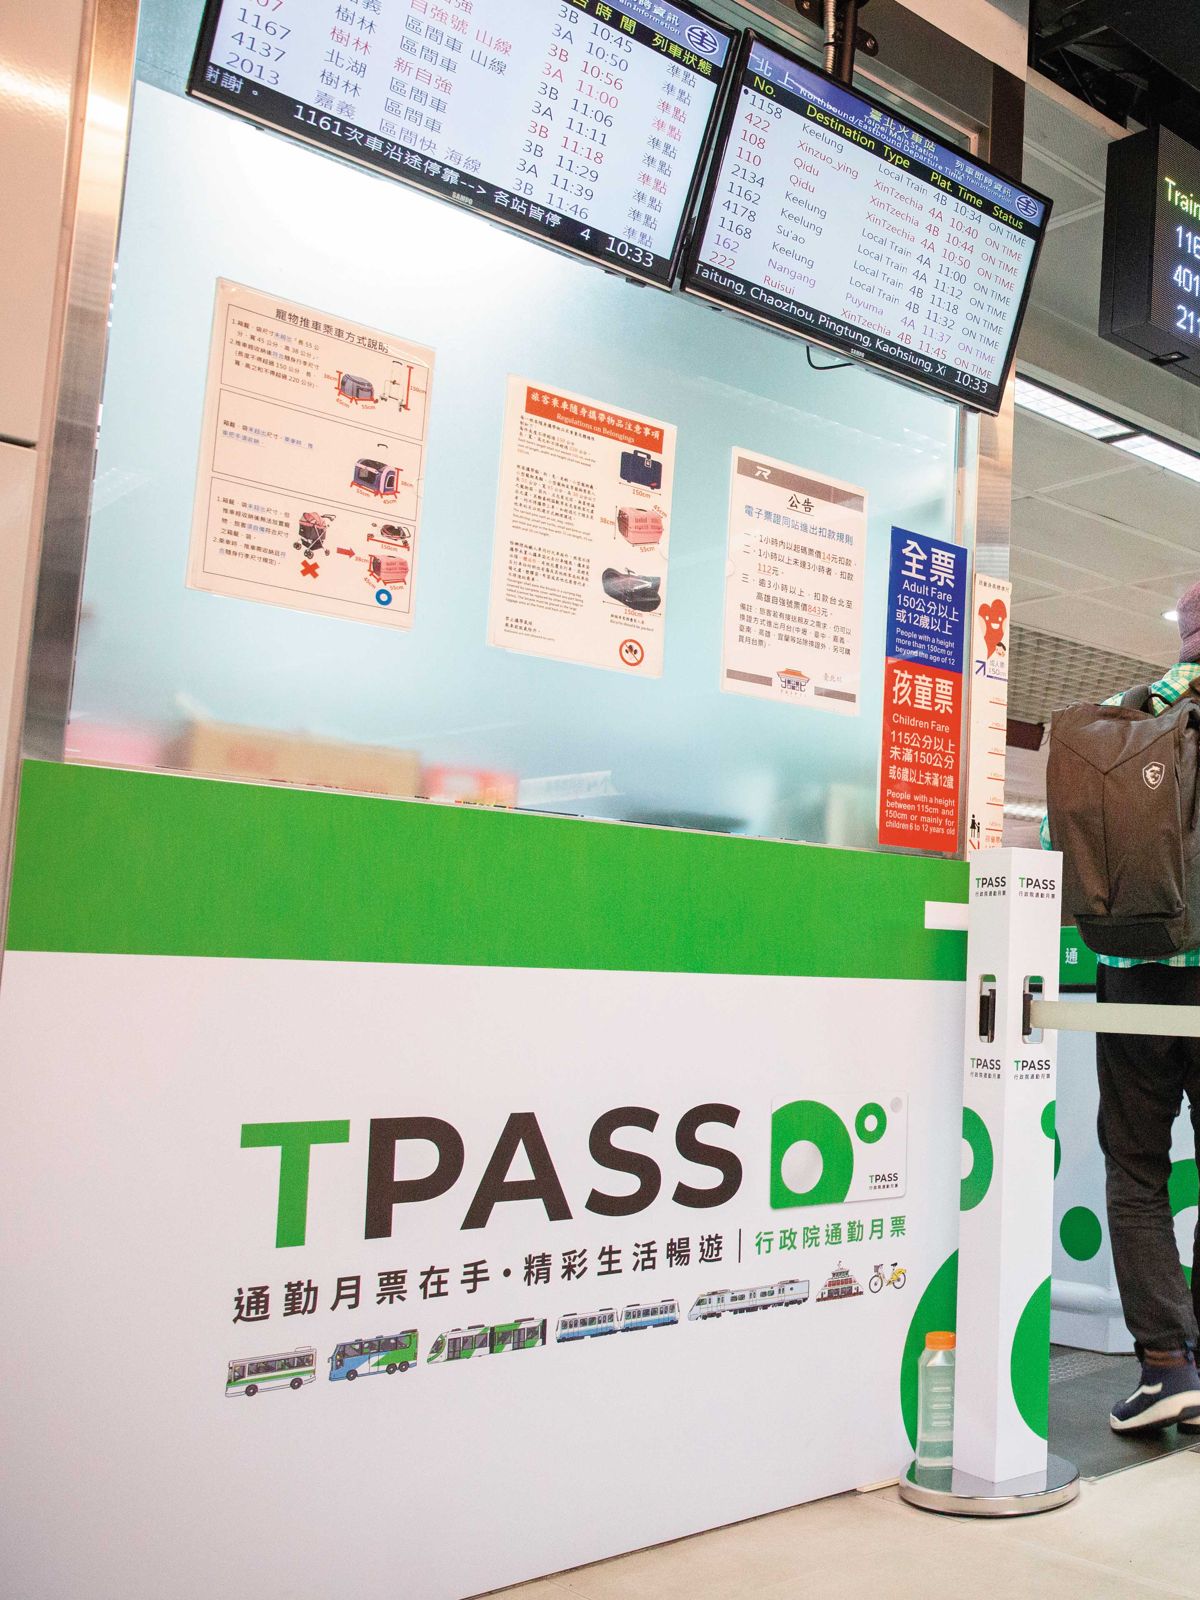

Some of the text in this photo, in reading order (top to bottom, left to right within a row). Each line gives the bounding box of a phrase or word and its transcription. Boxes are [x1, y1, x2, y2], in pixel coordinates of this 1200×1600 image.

[590, 22, 633, 54] 10:45
[652, 33, 713, 76] 列車狀態
[235, 7, 664, 213] 1167 北湖 區間車 3B 11:29 準點
[230, 28, 659, 231] 4137 樹林 區間車 3A 11:39 準點
[225, 50, 654, 248] 2013 嘉義 區間快 海線 3B 11:46 準點
[753, 75, 1024, 230] No. Destination Type Plat. Time Status
[744, 109, 770, 134] 422
[873, 178, 924, 213] XinTzechia
[927, 206, 944, 222] 4A
[949, 217, 978, 240] 10:40
[748, 92, 1026, 248] 1158 Keelung Local Train 4B 10:34 ON TIME
[492, 188, 562, 230] 各站皆停
[579, 226, 591, 240] 4
[605, 235, 654, 268] 10:33
[694, 262, 748, 297] Taitung,
[749, 285, 816, 325] Chaozhou,
[817, 314, 874, 349] Pingtung,
[874, 337, 935, 374] Kaohsiung,
[954, 370, 988, 394] 10:33
[557, 413, 592, 429] Regulations
[603, 428, 634, 442] Belongings
[788, 494, 814, 512] 公告
[901, 537, 955, 589] 全票
[903, 578, 952, 602] Adult Fare
[895, 607, 952, 635] 或12歲以上
[896, 592, 959, 622] 150公分以上
[895, 627, 916, 639] People
[917, 633, 929, 642] with
[935, 637, 954, 649] height
[895, 636, 909, 645] more
[910, 639, 925, 650] than
[926, 643, 945, 655] 150cm
[891, 667, 953, 715] 孩童票
[892, 712, 949, 733] Children Fare
[890, 728, 955, 755] 115公分以上
[889, 745, 954, 770] 未滿150公分
[888, 764, 954, 789] 或6歲以上未滿12歲
[976, 877, 1006, 888] TPASS
[1019, 877, 1055, 890] TPASS
[970, 1058, 1001, 1070] TPASS
[1014, 1060, 1050, 1071] TPASS
[240, 1103, 743, 1248] TPASS
[869, 1173, 899, 1183] TPASS
[755, 1215, 907, 1256] 行政院通勤月票
